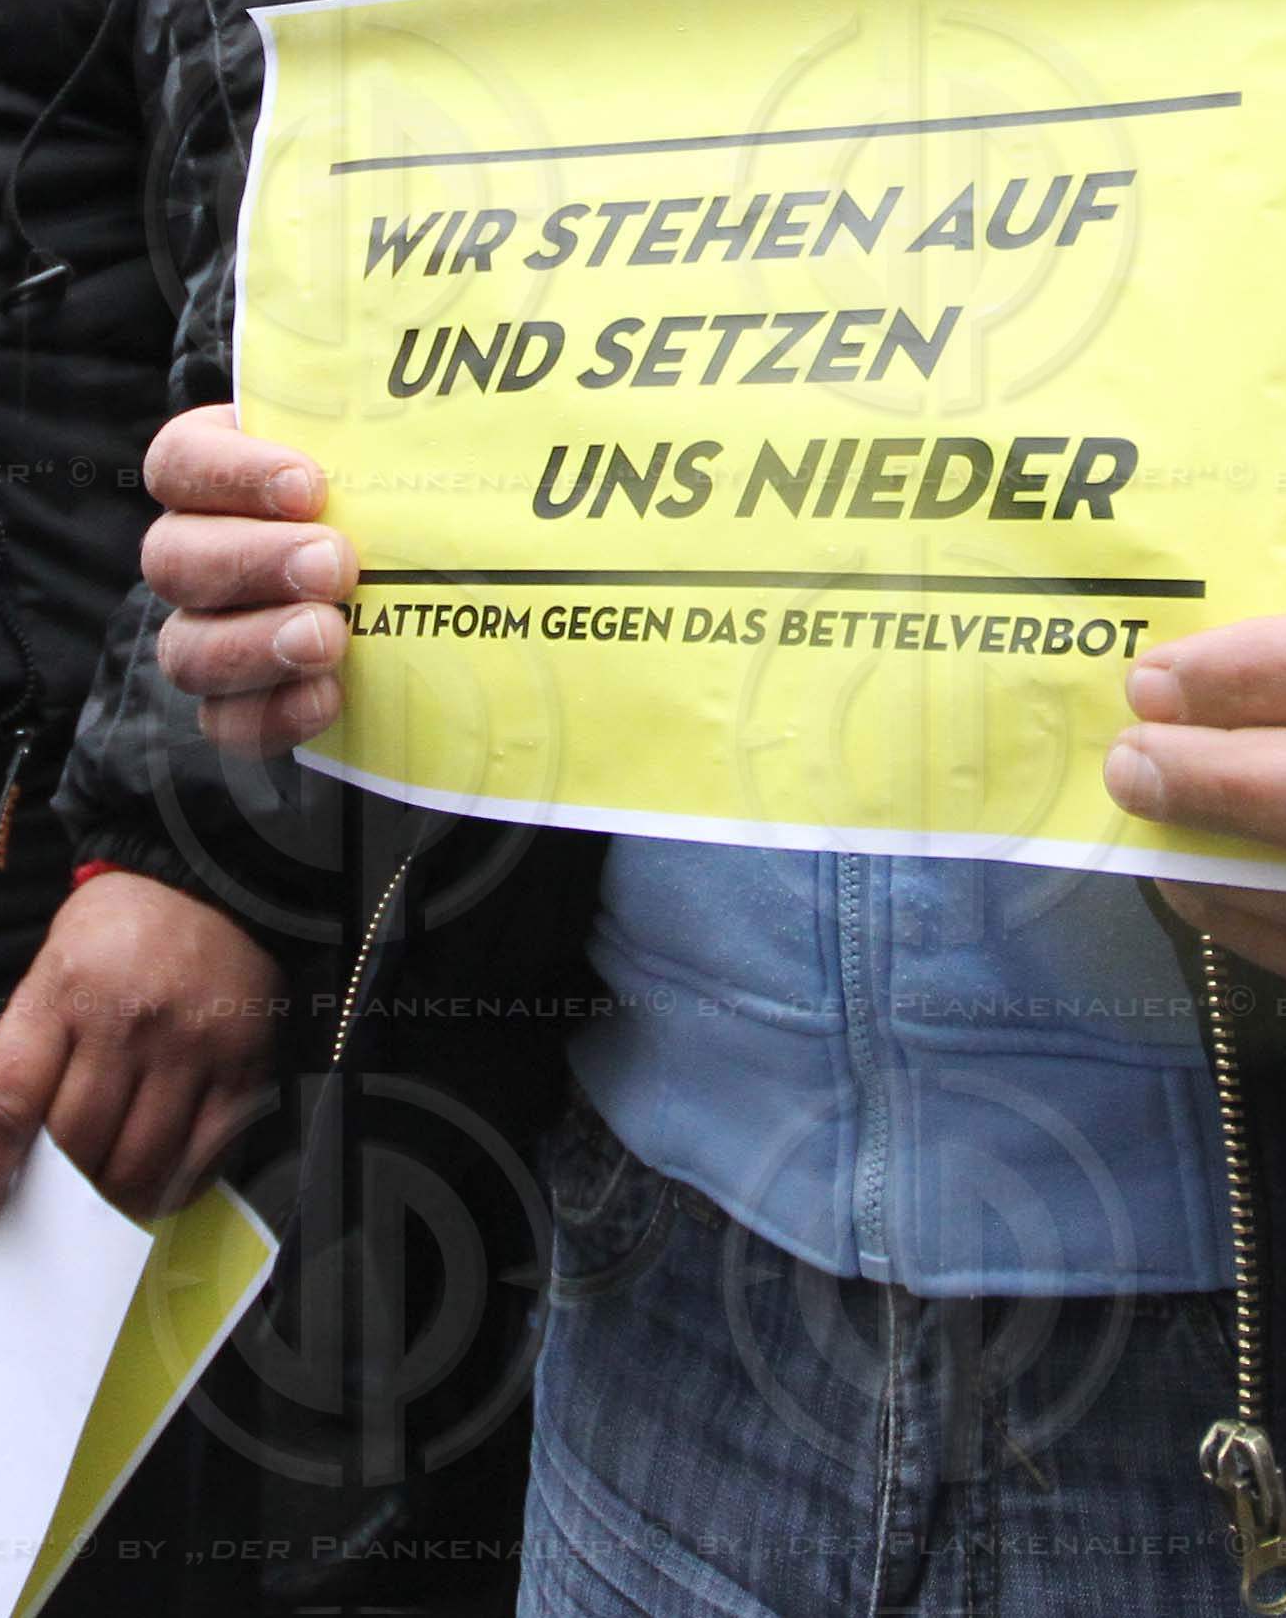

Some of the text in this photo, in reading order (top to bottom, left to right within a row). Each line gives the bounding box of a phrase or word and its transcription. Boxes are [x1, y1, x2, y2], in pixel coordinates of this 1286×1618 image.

[363, 169, 1138, 280] WIR STEHEN AUF
[386, 305, 965, 399] UND SETZEN
[532, 439, 724, 520] UNS
[733, 436, 1139, 520] NIEDER
[540, 605, 674, 642] GEGEN
[681, 606, 768, 646] DAS
[777, 609, 1150, 660] BETTELVERBOT
